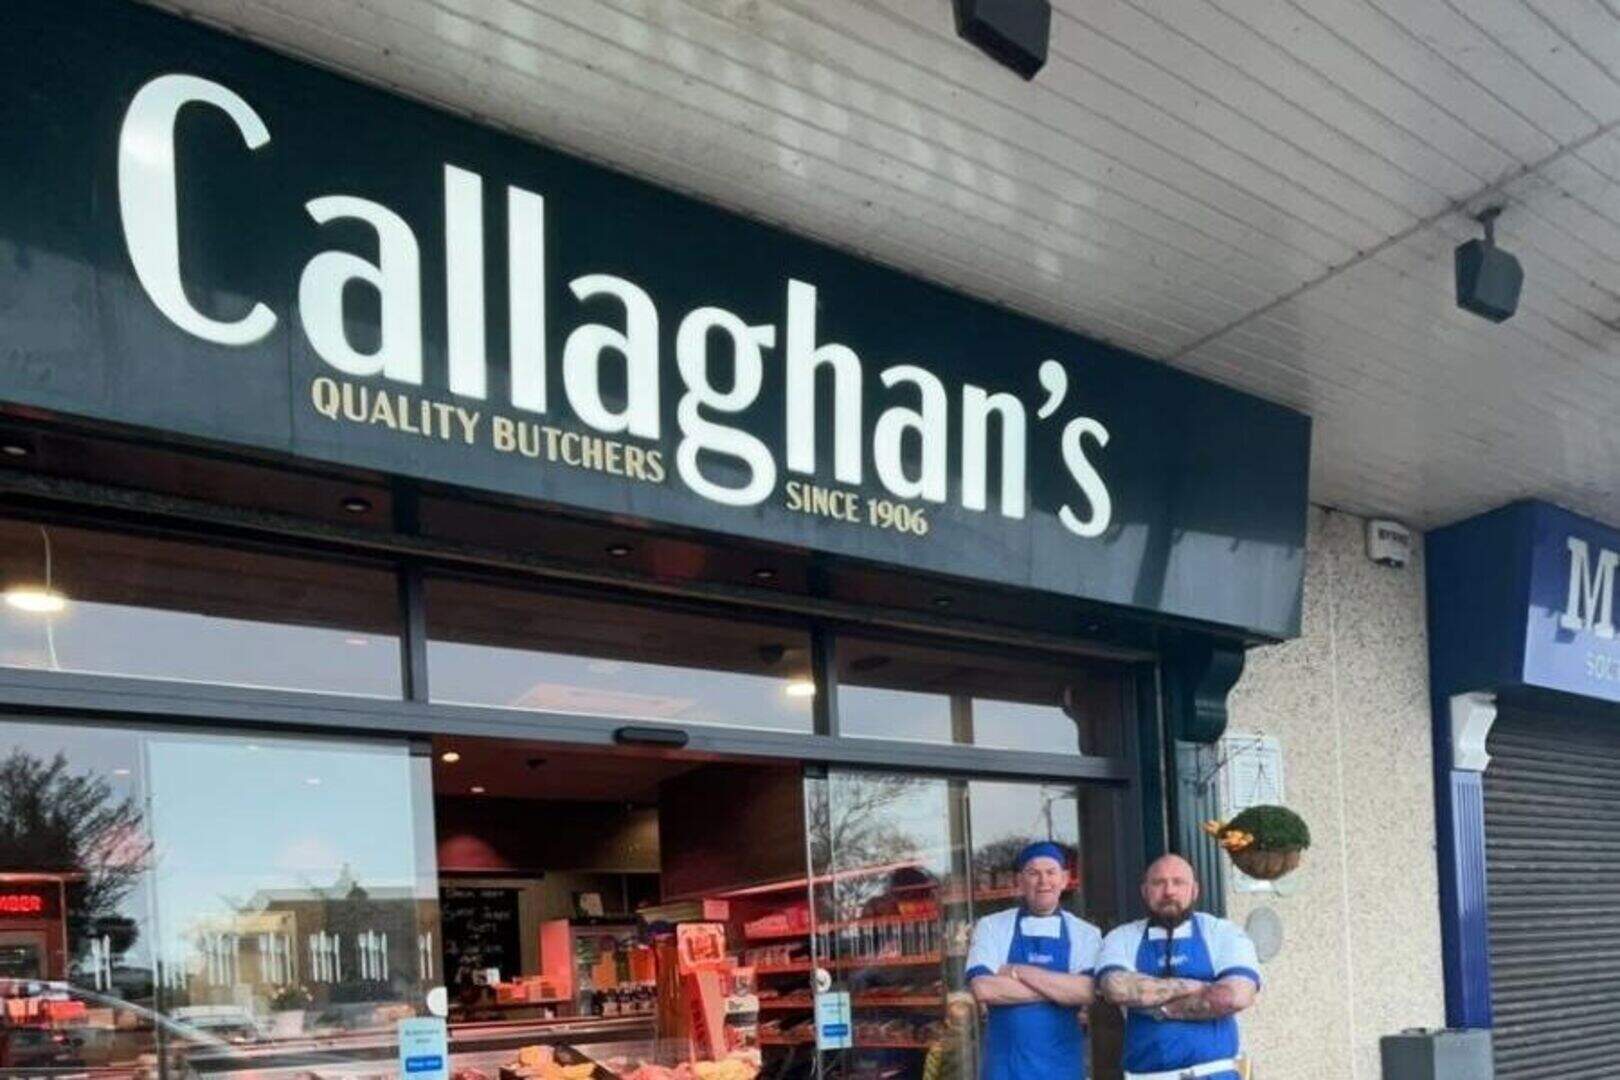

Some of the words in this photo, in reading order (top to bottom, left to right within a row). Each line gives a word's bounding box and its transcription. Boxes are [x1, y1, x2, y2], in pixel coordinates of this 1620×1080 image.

[117, 73, 1112, 538] Callaghan's
[311, 377, 480, 446] QUALITY
[492, 415, 665, 484] BUTCHERS
[785, 480, 861, 524] SINCE
[867, 497, 930, 536] 1906
